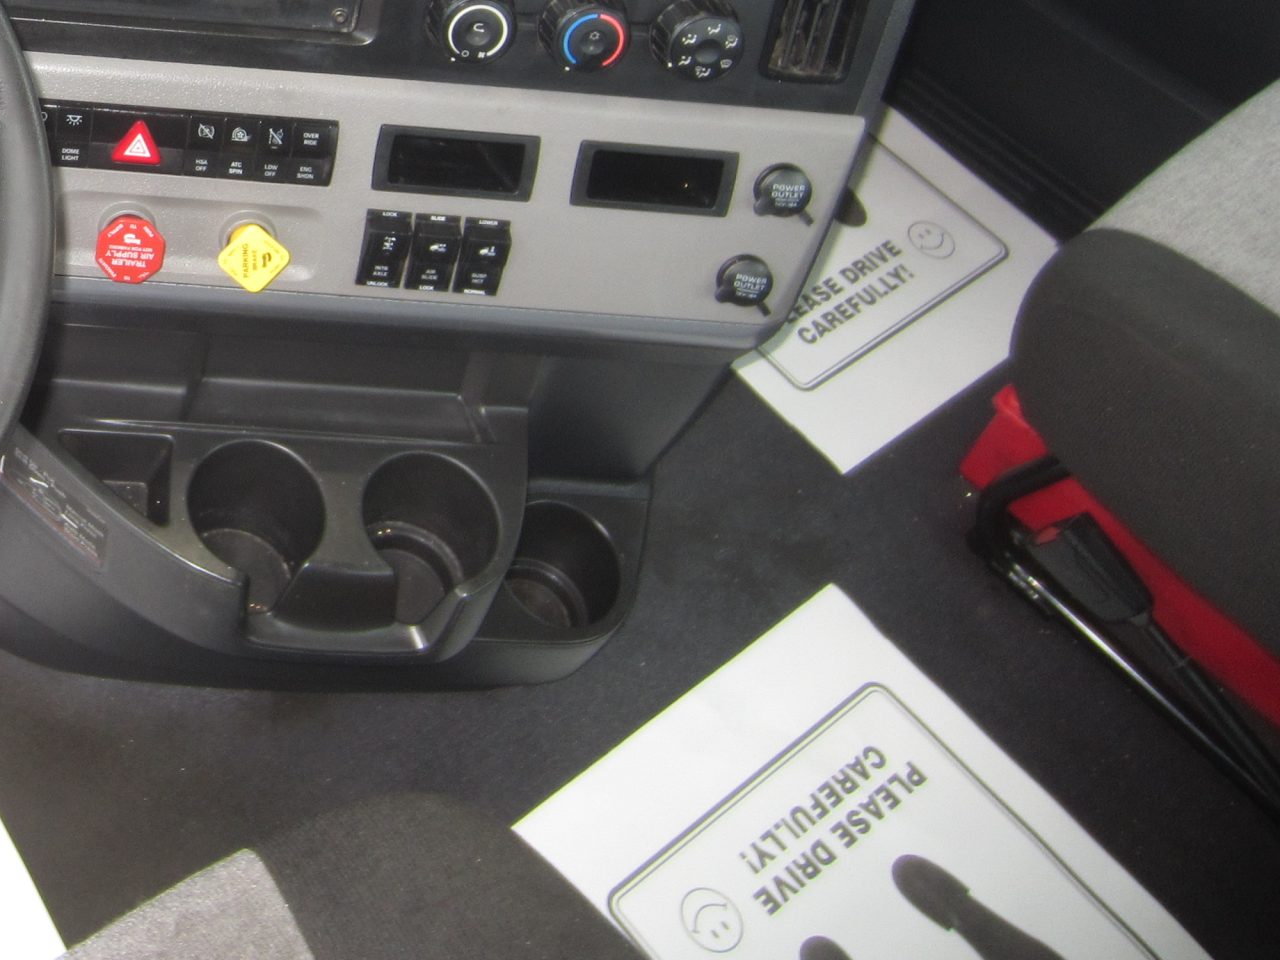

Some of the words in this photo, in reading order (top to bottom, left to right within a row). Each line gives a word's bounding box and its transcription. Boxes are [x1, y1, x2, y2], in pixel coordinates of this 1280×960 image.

[772, 183, 806, 192] POWER
[771, 190, 805, 198] OUTLET
[105, 250, 139, 259] SUPPLY
[140, 253, 155, 261] AIR
[111, 258, 146, 268] TRAILER
[735, 273, 768, 284] POWER
[786, 277, 844, 324] EASE
[839, 240, 902, 284] DRIVE
[733, 280, 765, 291] OUTLET
[797, 264, 915, 344] CAREFULLY!
[739, 746, 887, 874] CAREFULLY!
[830, 761, 928, 848] PLEASE
[753, 838, 837, 916] DRIVE
